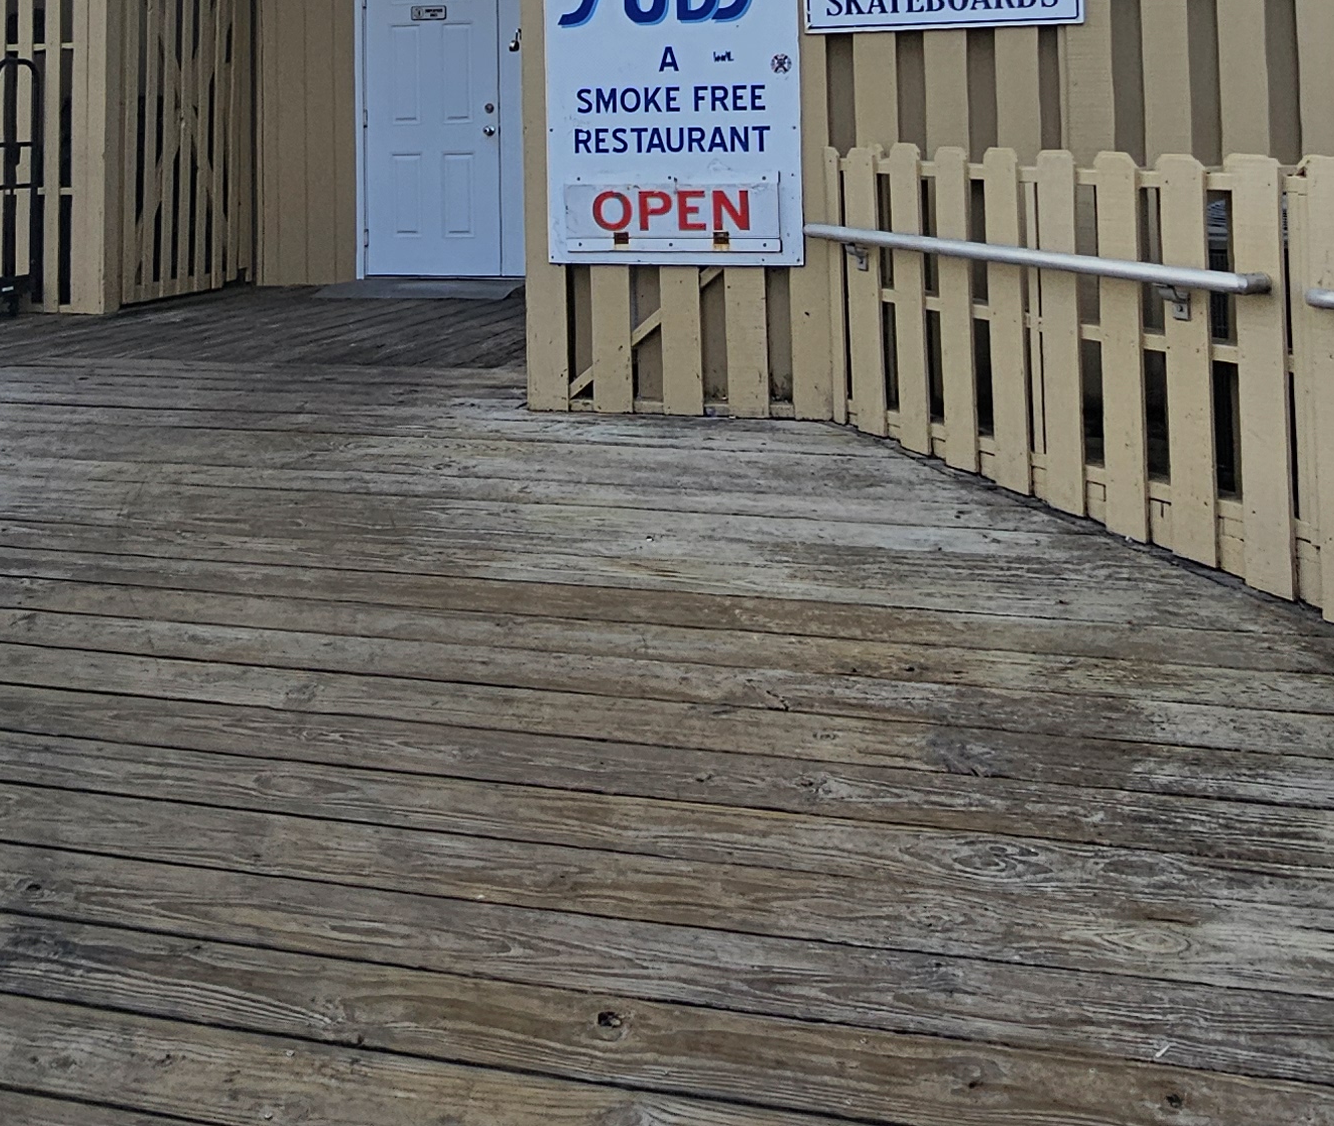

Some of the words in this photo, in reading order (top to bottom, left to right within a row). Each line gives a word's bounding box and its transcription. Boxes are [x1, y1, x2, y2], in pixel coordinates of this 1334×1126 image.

[658, 46, 679, 72] A
[576, 86, 681, 114] SMOKE
[693, 84, 766, 112] FREE
[574, 125, 771, 154] RESTAURANT
[591, 189, 751, 232] OPEN
